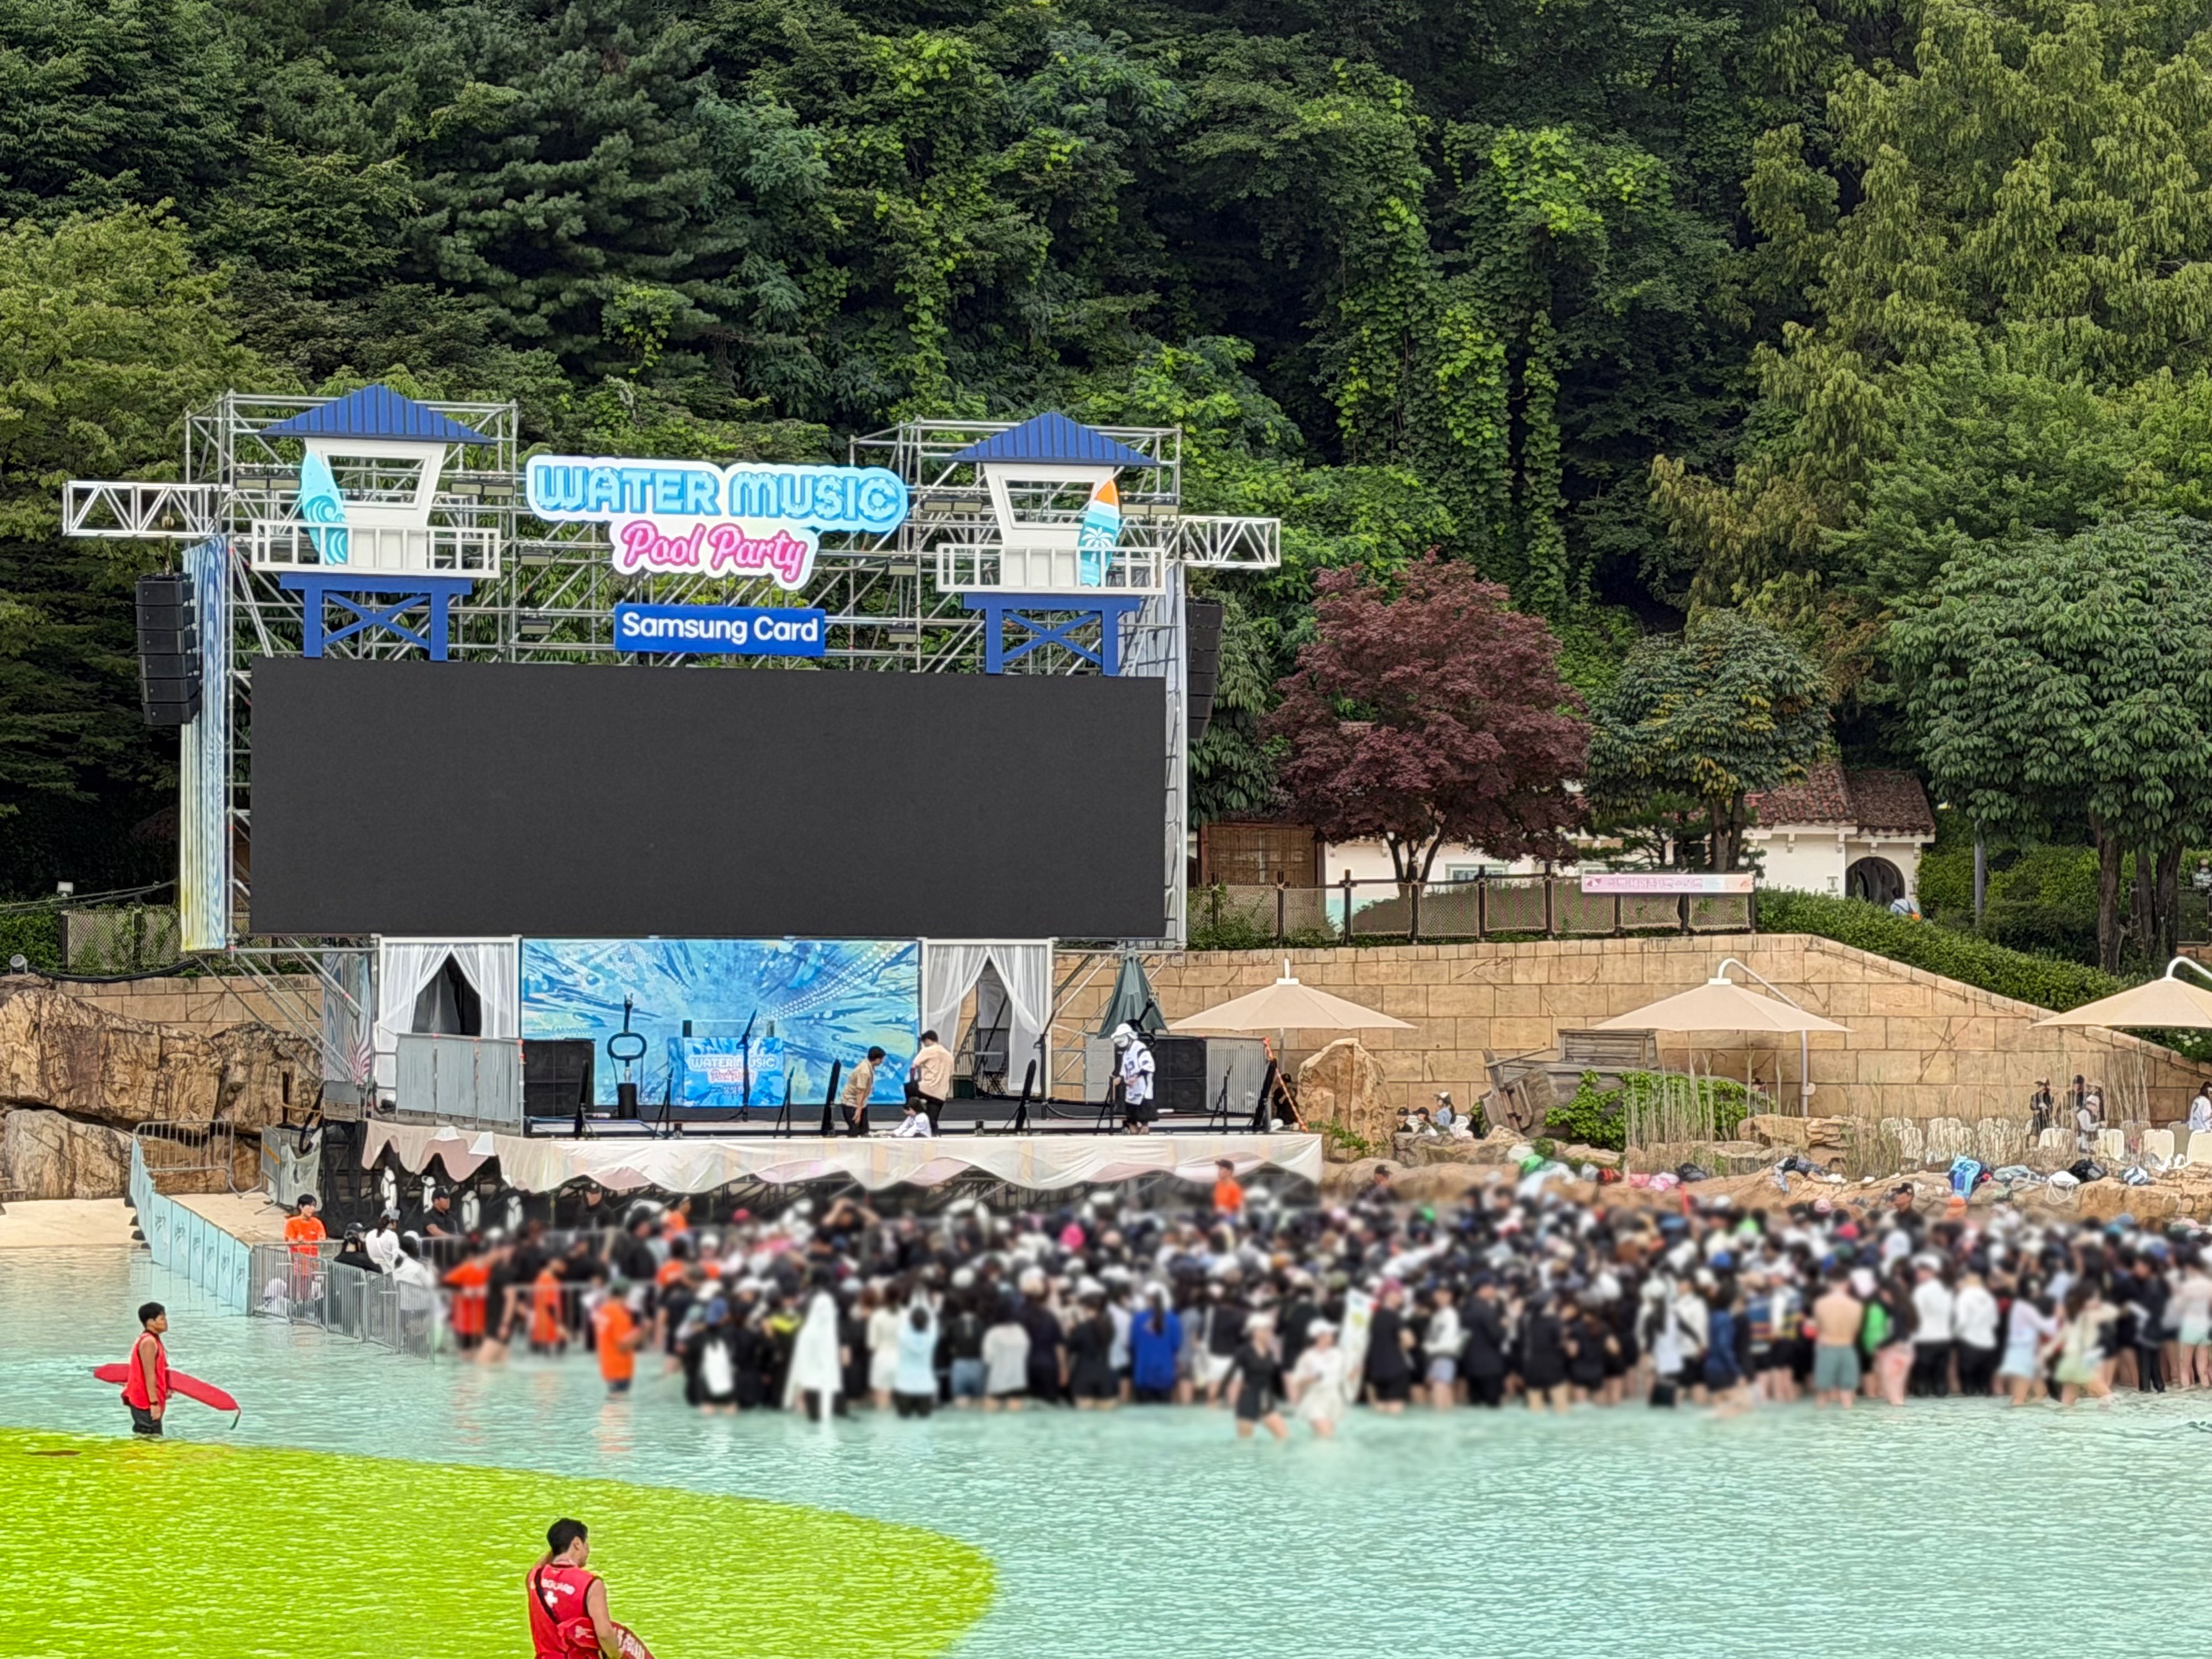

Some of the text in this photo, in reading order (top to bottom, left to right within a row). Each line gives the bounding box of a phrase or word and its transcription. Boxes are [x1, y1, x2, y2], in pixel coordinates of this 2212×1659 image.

[535, 465, 900, 523] WATER MUSIC
[620, 520, 808, 582] Pool Party
[622, 612, 818, 645] Samsung Card
[691, 1057, 733, 1068] WATER
